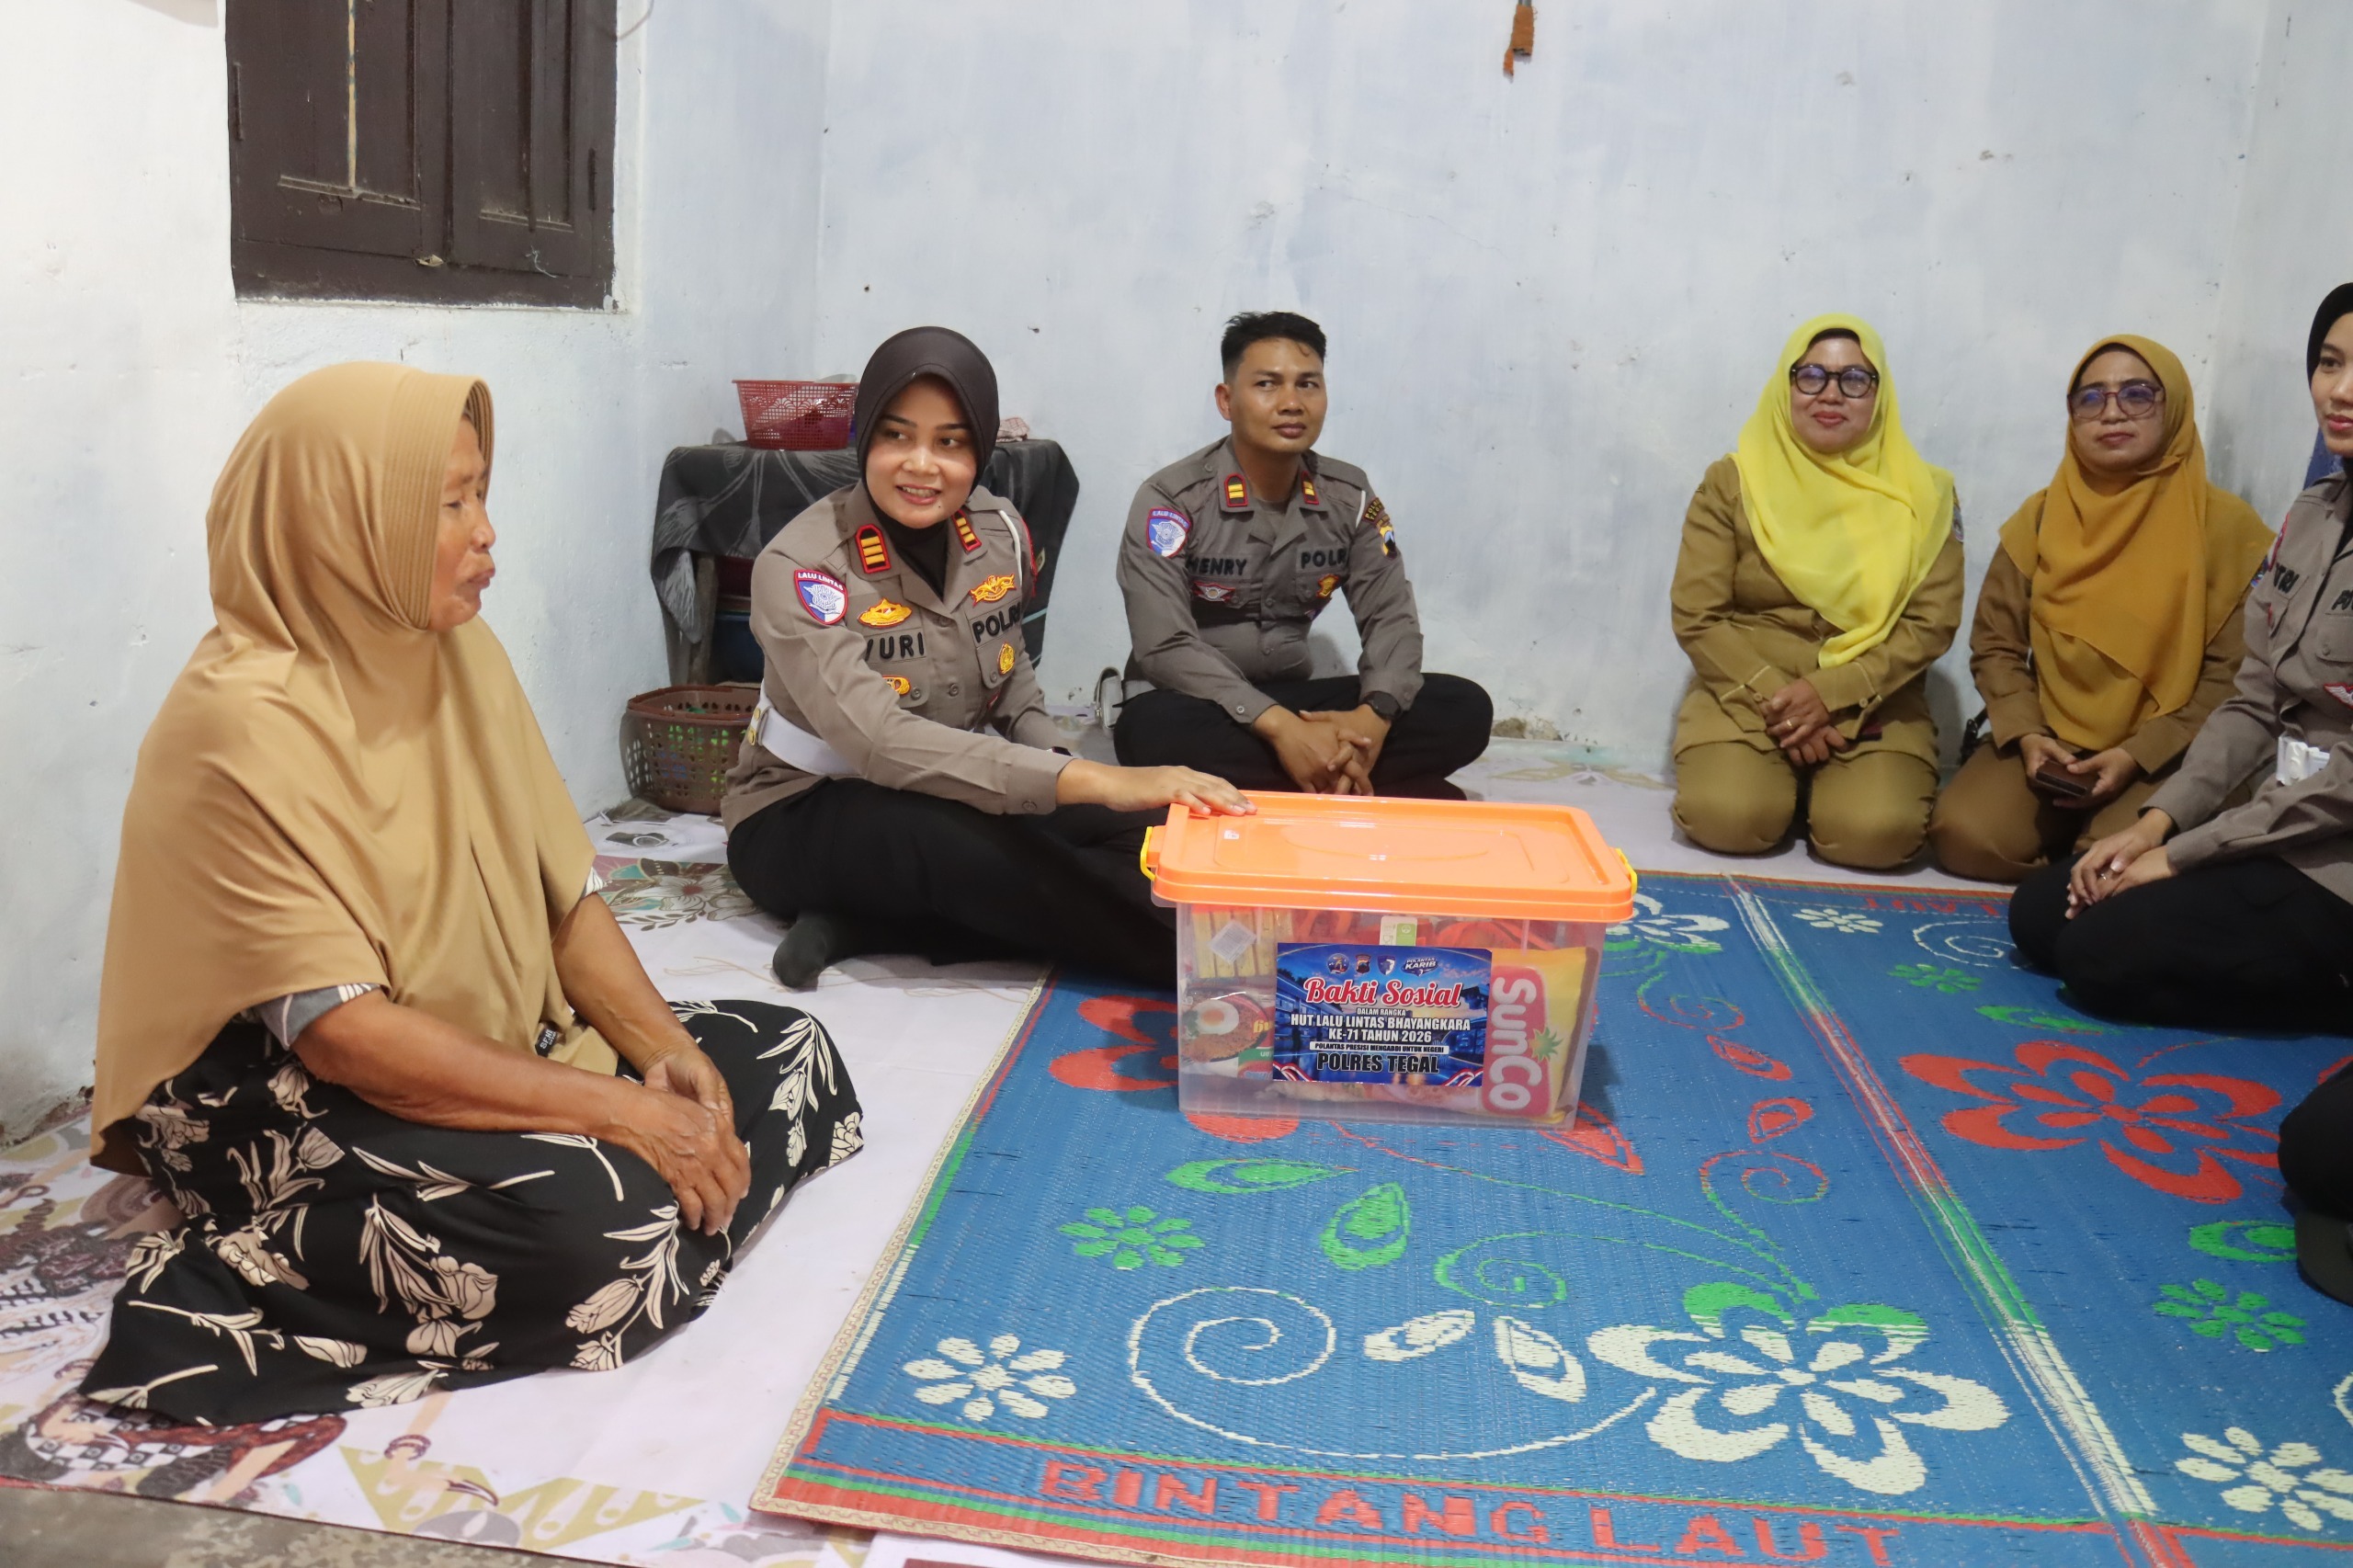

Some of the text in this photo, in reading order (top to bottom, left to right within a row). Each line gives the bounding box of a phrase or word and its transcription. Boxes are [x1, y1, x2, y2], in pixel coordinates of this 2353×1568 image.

[1169, 512, 1189, 529] LINTAS
[1187, 557, 1247, 575] HENRY
[818, 574, 844, 590] LINTAS
[865, 632, 925, 661] URI
[1404, 961, 1436, 970] KARIB
[1303, 977, 1462, 1007] Bakti Sosial
[1291, 1014, 1471, 1030] HUT LALU LINTAS BHAYANGKARA
[1328, 1028, 1432, 1043] KE-71 TAHUN 2026
[1488, 976, 1542, 1109] SunCo
[1314, 1042, 1345, 1051] POLANTAS
[1370, 1044, 1402, 1052] MENGABDI
[1317, 1052, 1439, 1074] POLRES TEGAL
[1040, 1460, 1901, 1567] BINTANG LAUT
